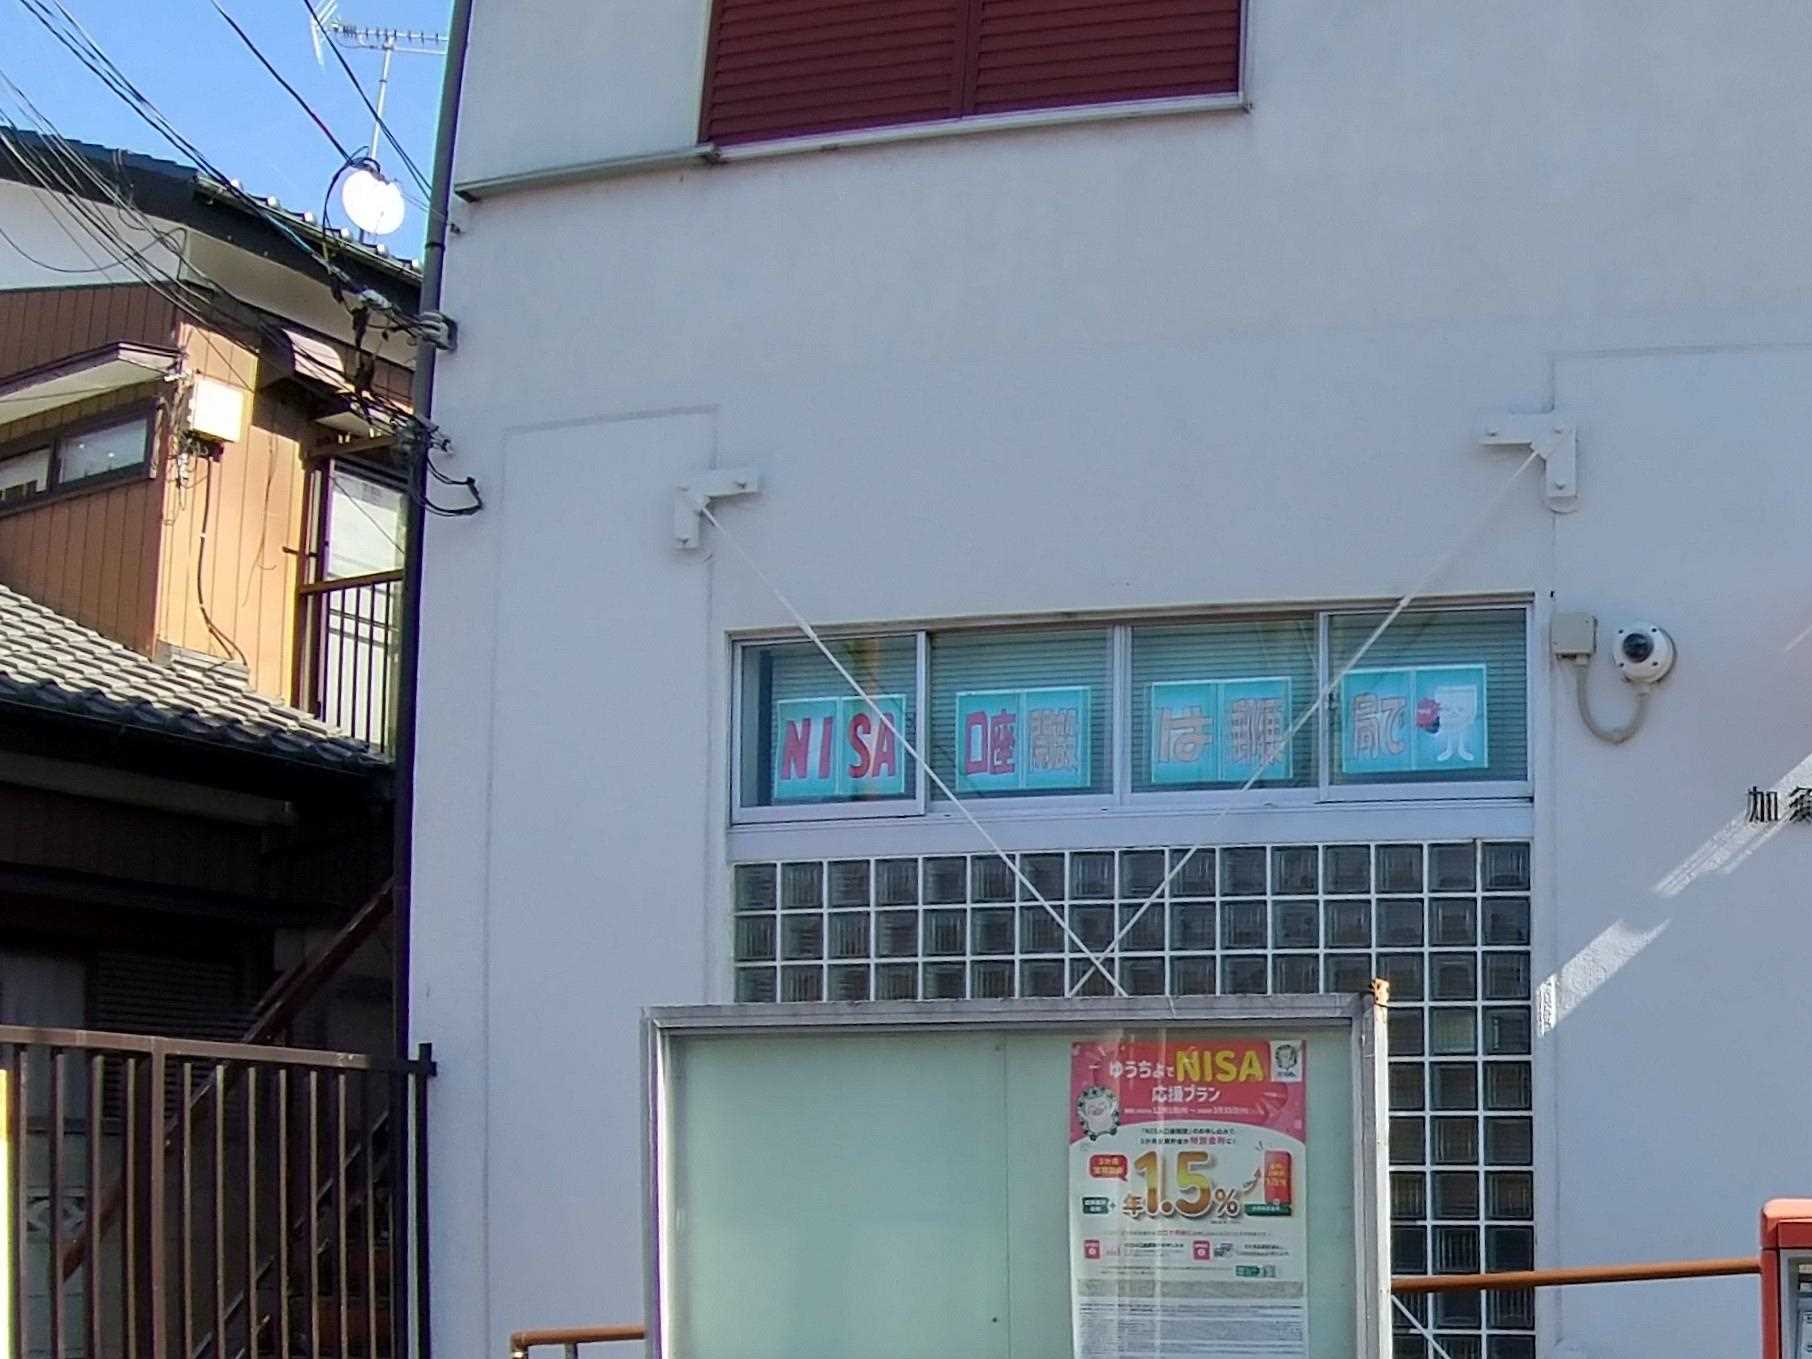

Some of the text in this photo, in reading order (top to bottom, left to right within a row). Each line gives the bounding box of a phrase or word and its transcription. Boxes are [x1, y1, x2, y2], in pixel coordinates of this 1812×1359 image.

[780, 711, 897, 781] NISA
[1152, 1085, 1221, 1102] 応援プラン
